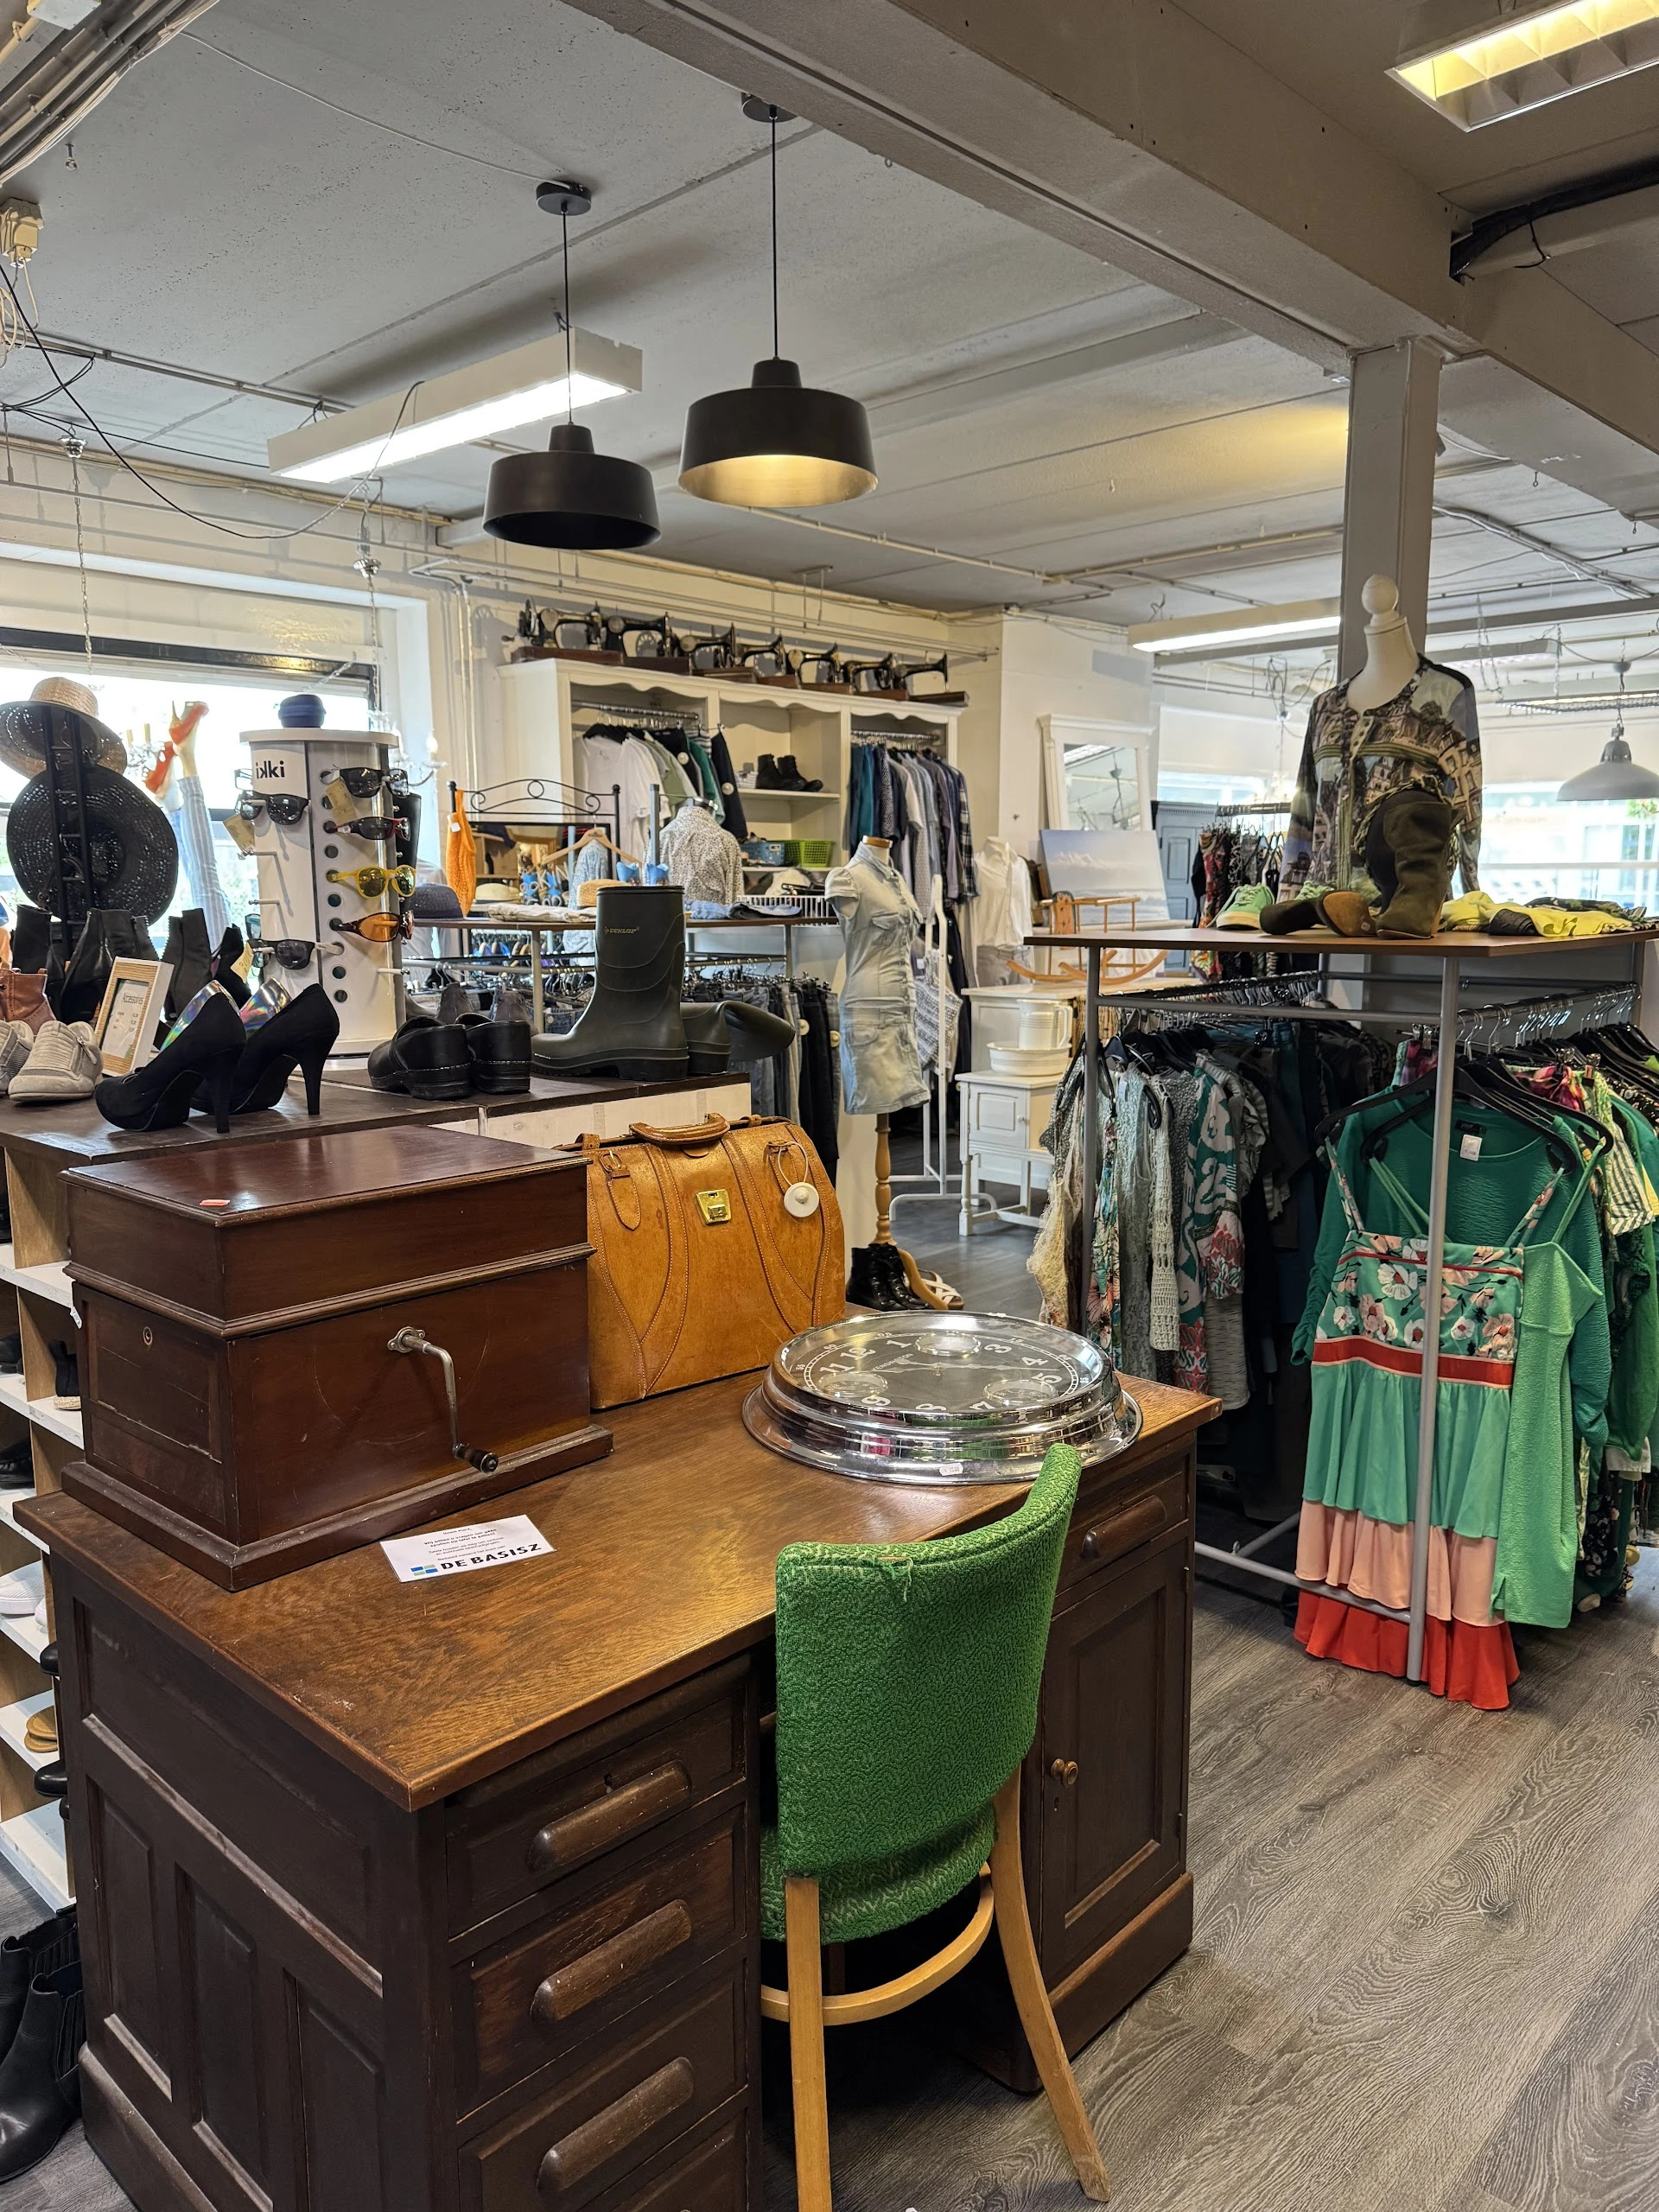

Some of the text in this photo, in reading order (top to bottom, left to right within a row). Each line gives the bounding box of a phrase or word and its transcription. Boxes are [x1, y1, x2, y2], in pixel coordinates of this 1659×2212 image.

[840, 1347, 876, 1360] 12
[984, 1344, 1013, 1353] 3
[1021, 1357, 1049, 1366] 4
[819, 1363, 855, 1373] 11
[1032, 1372, 1063, 1383] 5
[861, 1395, 891, 1407] 9
[969, 1401, 996, 1410] 7
[440, 1560, 467, 1570] DE
[470, 1543, 542, 1564] BASISZ
